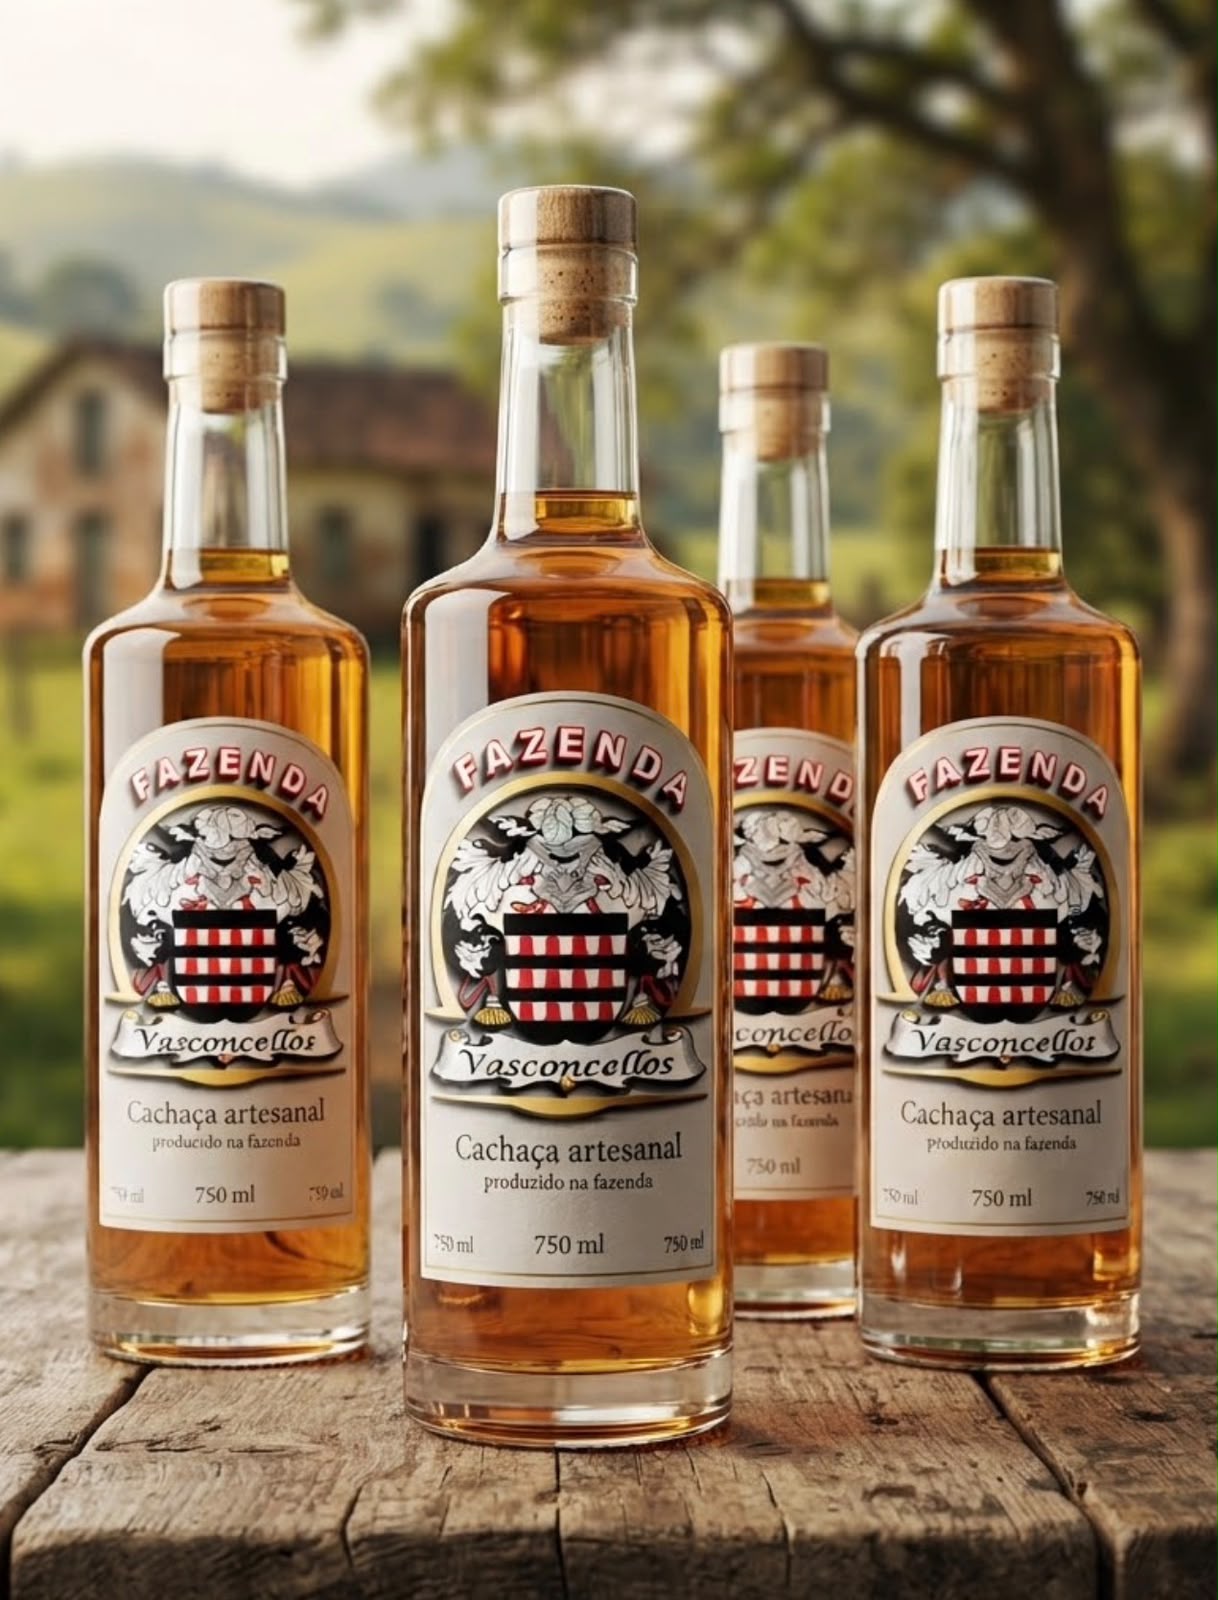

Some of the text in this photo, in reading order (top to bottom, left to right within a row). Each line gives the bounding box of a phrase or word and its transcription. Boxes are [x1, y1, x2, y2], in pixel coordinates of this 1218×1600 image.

[451, 726, 688, 812] FAZENDA
[734, 754, 855, 807] ZEND
[906, 746, 1108, 819] FAZENDA
[131, 747, 329, 820] FAZENDA
[736, 1020, 852, 1048] concello
[459, 1050, 674, 1080] Vasconcellos
[771, 1086, 853, 1105] artesana
[127, 1097, 325, 1130] Cachaça artesanal
[901, 1099, 1102, 1131] Cachaça artesanal
[227, 1138, 244, 1149] na
[456, 1131, 682, 1169] Cachaça artesanal
[1003, 1139, 1021, 1151] na
[195, 1185, 255, 1203] 750 ml
[484, 1172, 653, 1193] produzido na fazenda
[972, 1188, 1032, 1207] 750 ml
[534, 1233, 605, 1254] 750 ml
[664, 1234, 688, 1254] 750
